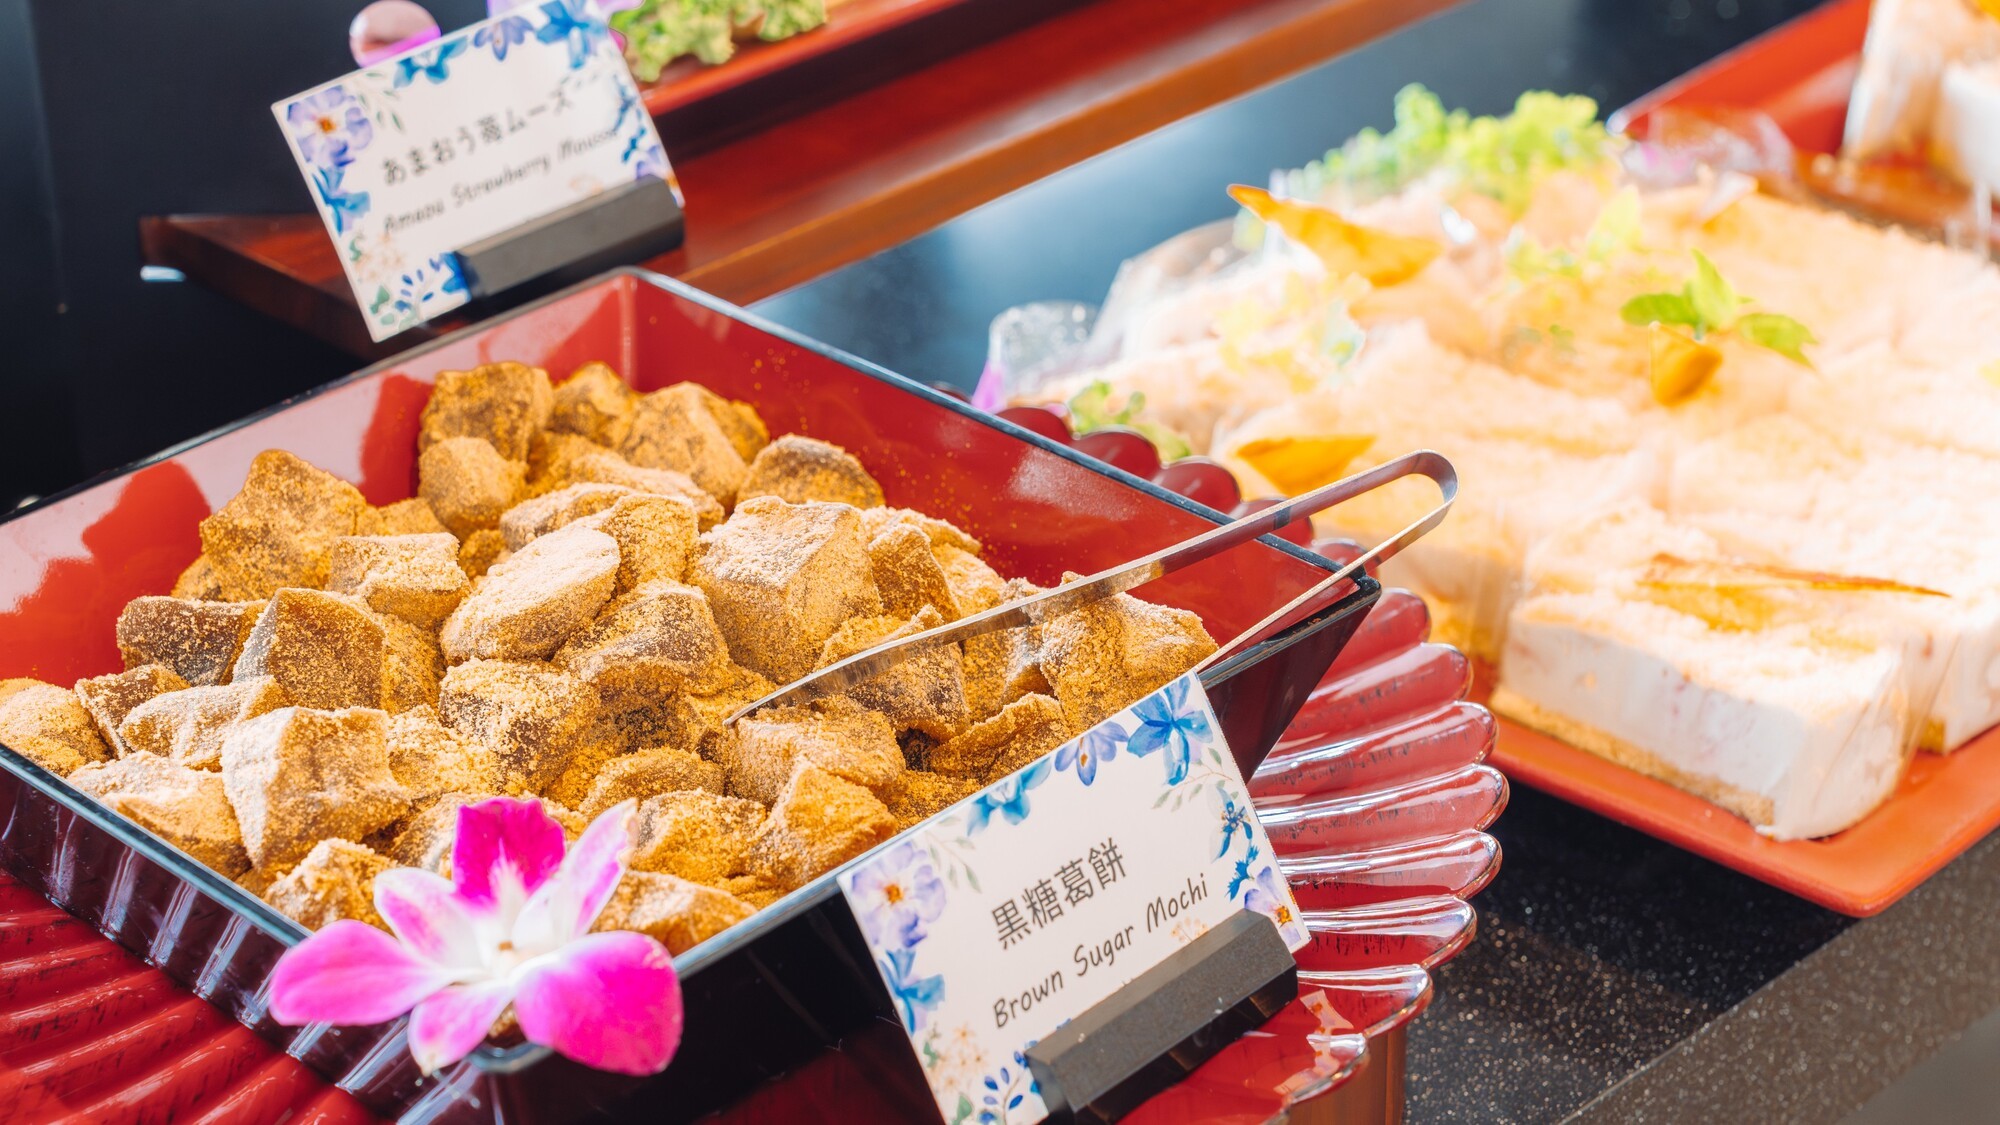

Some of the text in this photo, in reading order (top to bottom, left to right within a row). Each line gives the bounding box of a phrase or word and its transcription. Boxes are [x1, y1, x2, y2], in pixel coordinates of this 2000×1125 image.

[383, 90, 572, 186] あまおう苺ムース
[451, 156, 551, 206] Strawberry
[991, 838, 1126, 950] 黒糖葛餅
[993, 872, 1208, 1028] Brown Sugar Mochi
